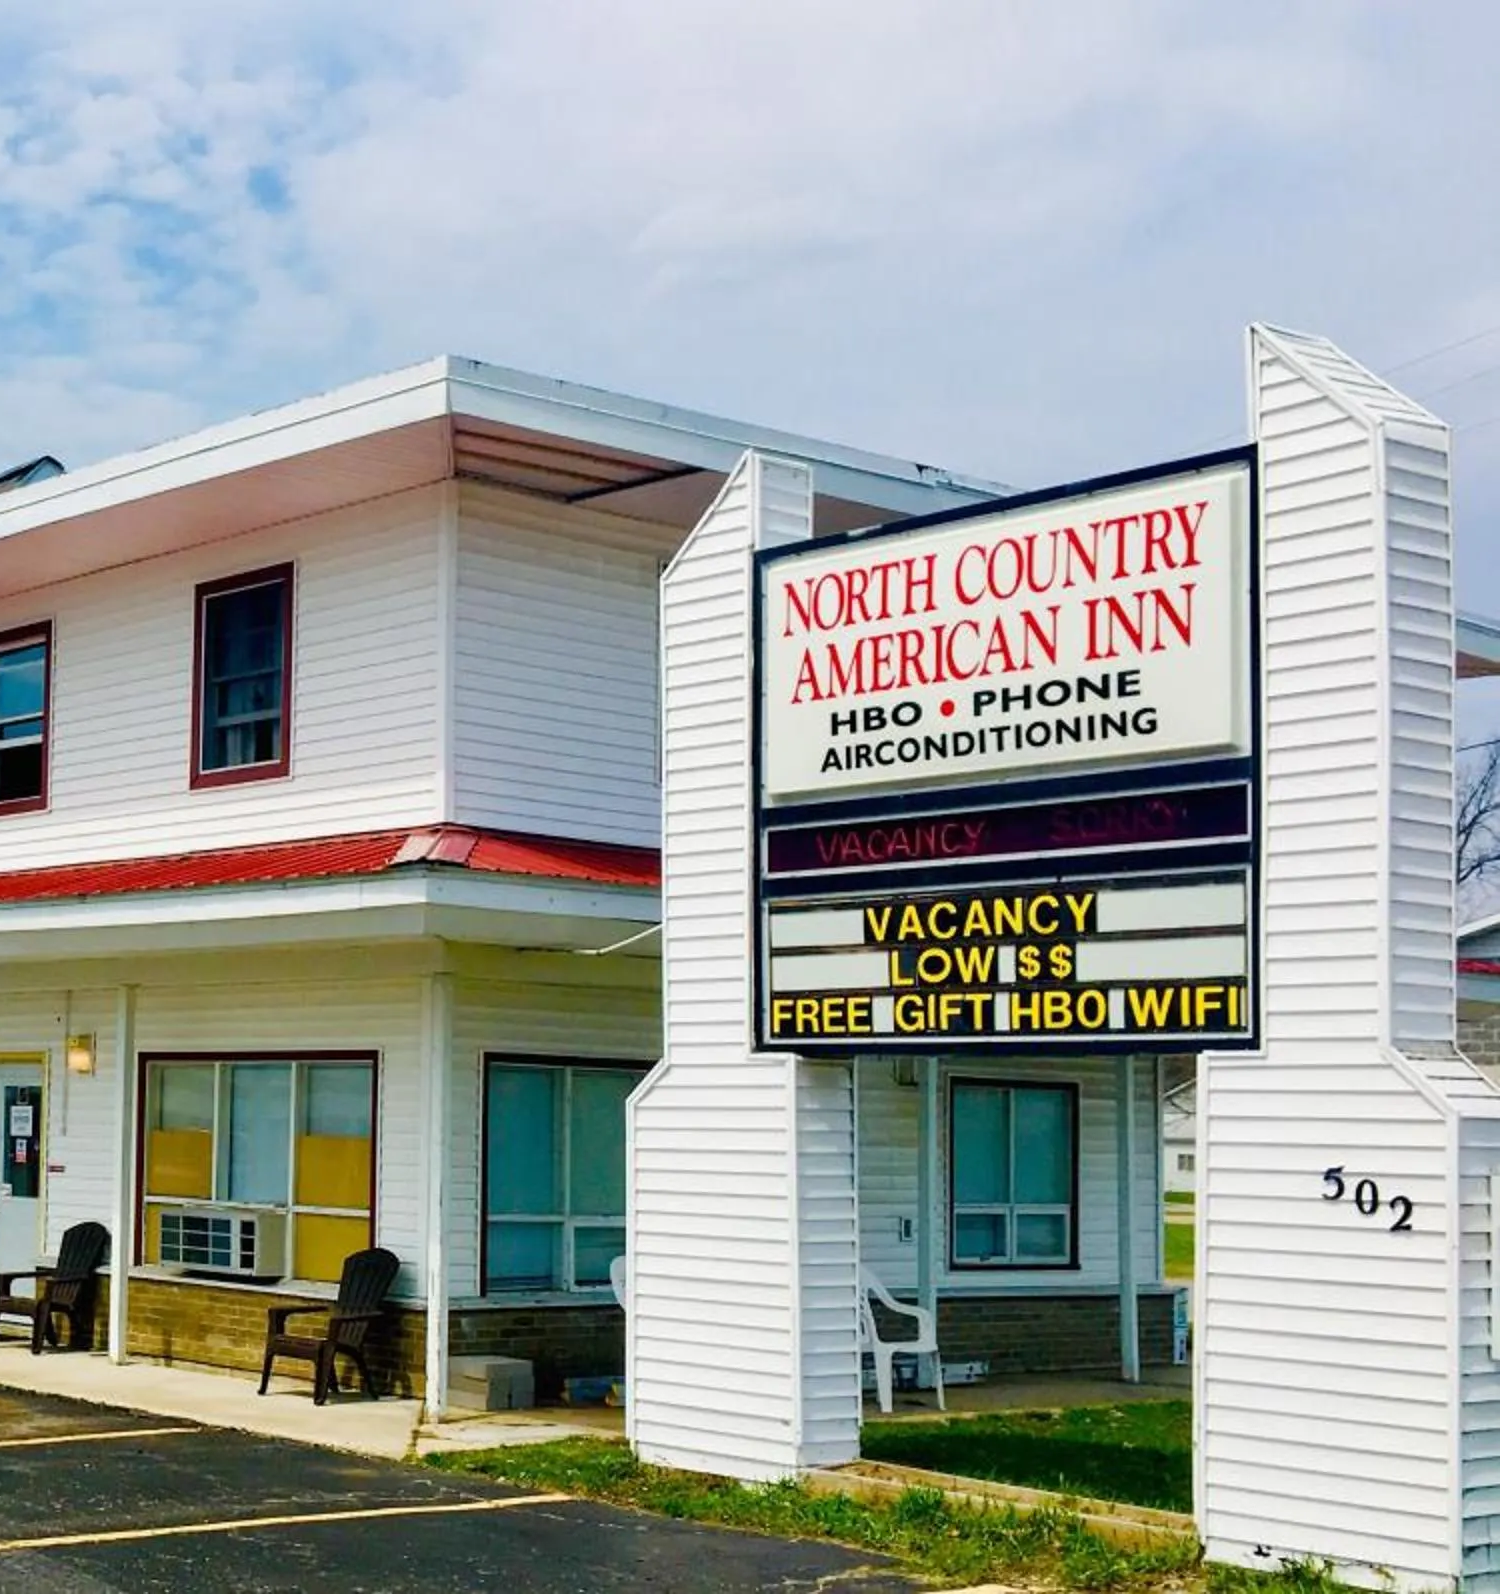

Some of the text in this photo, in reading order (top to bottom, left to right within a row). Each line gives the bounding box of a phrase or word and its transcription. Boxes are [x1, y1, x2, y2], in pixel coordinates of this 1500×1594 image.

[783, 501, 1209, 638] NORTH COUNTRY
[791, 583, 1196, 704] AMERICAN INN
[830, 669, 1142, 736] HBO PHONE
[820, 707, 1158, 773] AIRCONDITIONING
[816, 821, 986, 863] VACANCY
[866, 892, 1094, 941] VACANCY
[891, 944, 1073, 986] LOW $$
[772, 986, 1239, 1032] FREE GIFT HBO WIFI
[1322, 1166, 1414, 1232] 502
